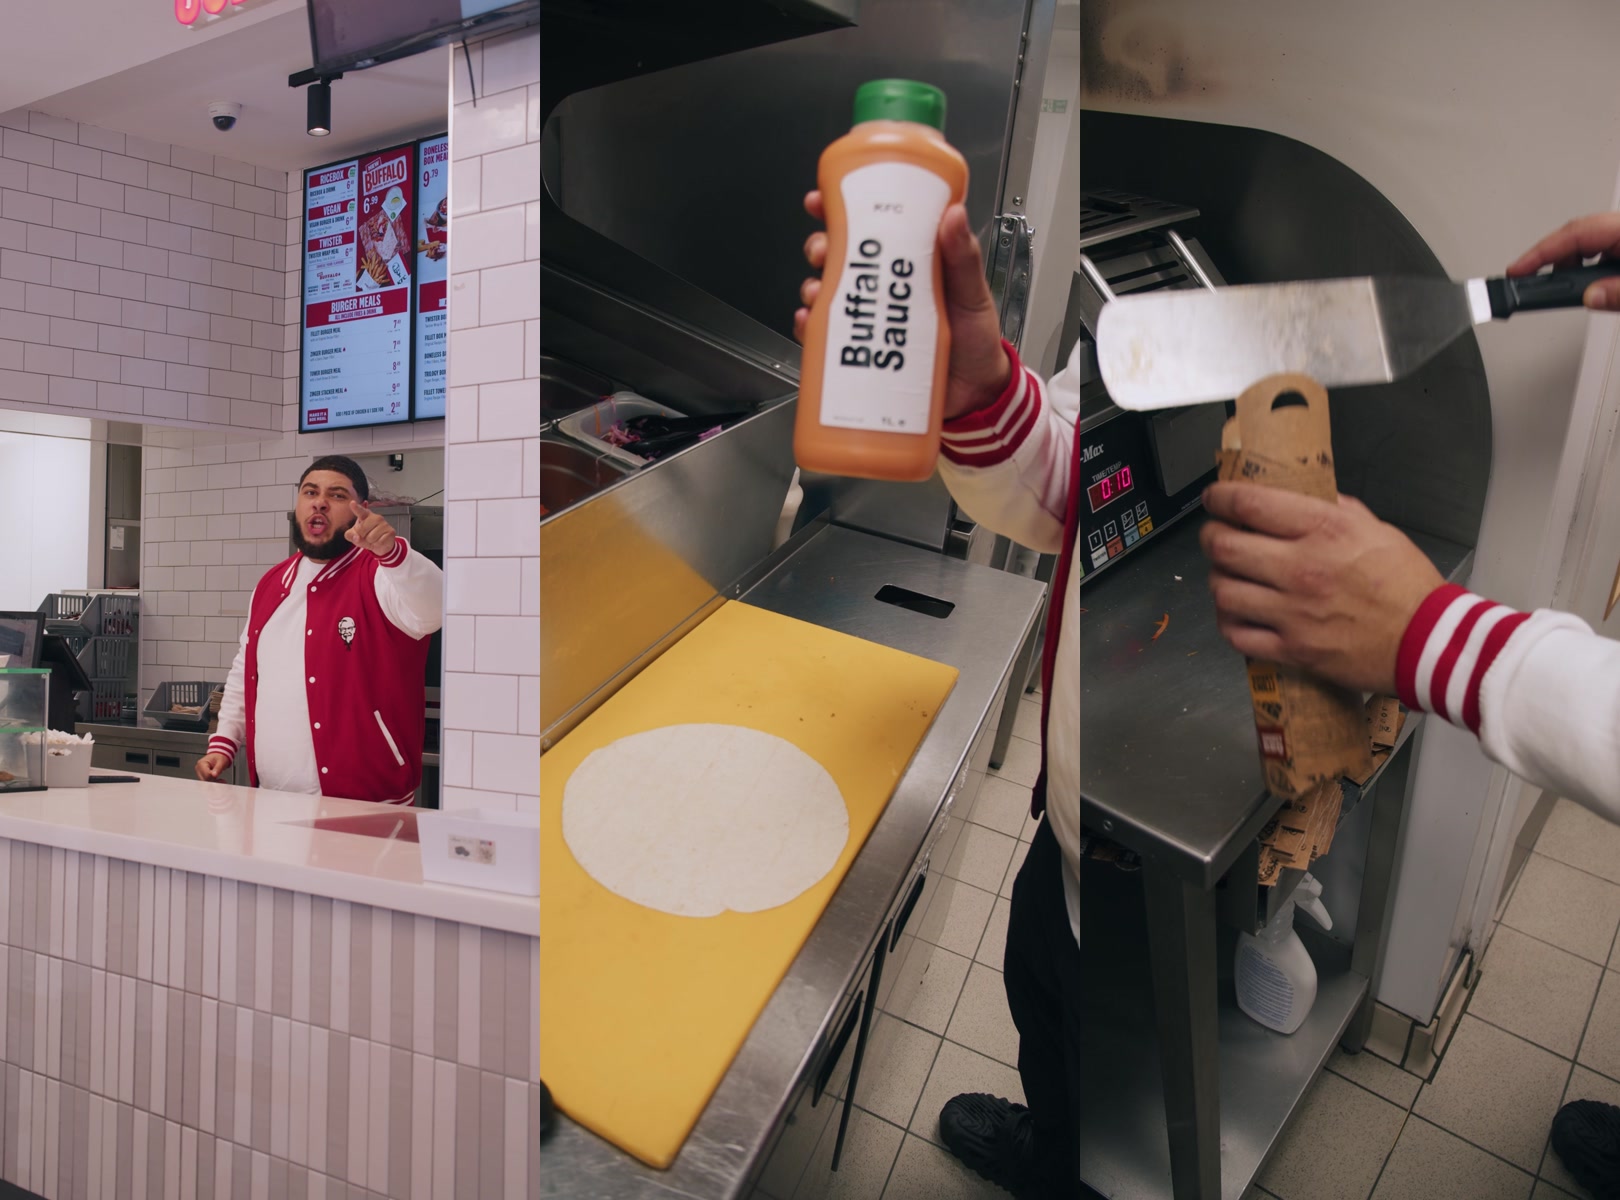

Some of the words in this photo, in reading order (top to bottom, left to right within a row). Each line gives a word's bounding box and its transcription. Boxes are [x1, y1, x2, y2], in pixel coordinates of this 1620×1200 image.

[424, 156, 434, 165] BOX
[320, 170, 344, 185] RICEBOX
[364, 159, 405, 193] BUFFALO
[423, 168, 439, 188] 9.79
[323, 203, 341, 216] VEGAN
[363, 196, 379, 214] 6.99
[874, 202, 904, 214] KFC
[319, 235, 342, 249] TWISTER
[331, 298, 358, 314] BURGER
[359, 294, 381, 309] MEALS
[840, 238, 882, 368] Buffalo
[873, 258, 914, 372] Sauce
[1092, 461, 1122, 483] TIME/TEMP
[1101, 467, 1132, 500] 0:10
